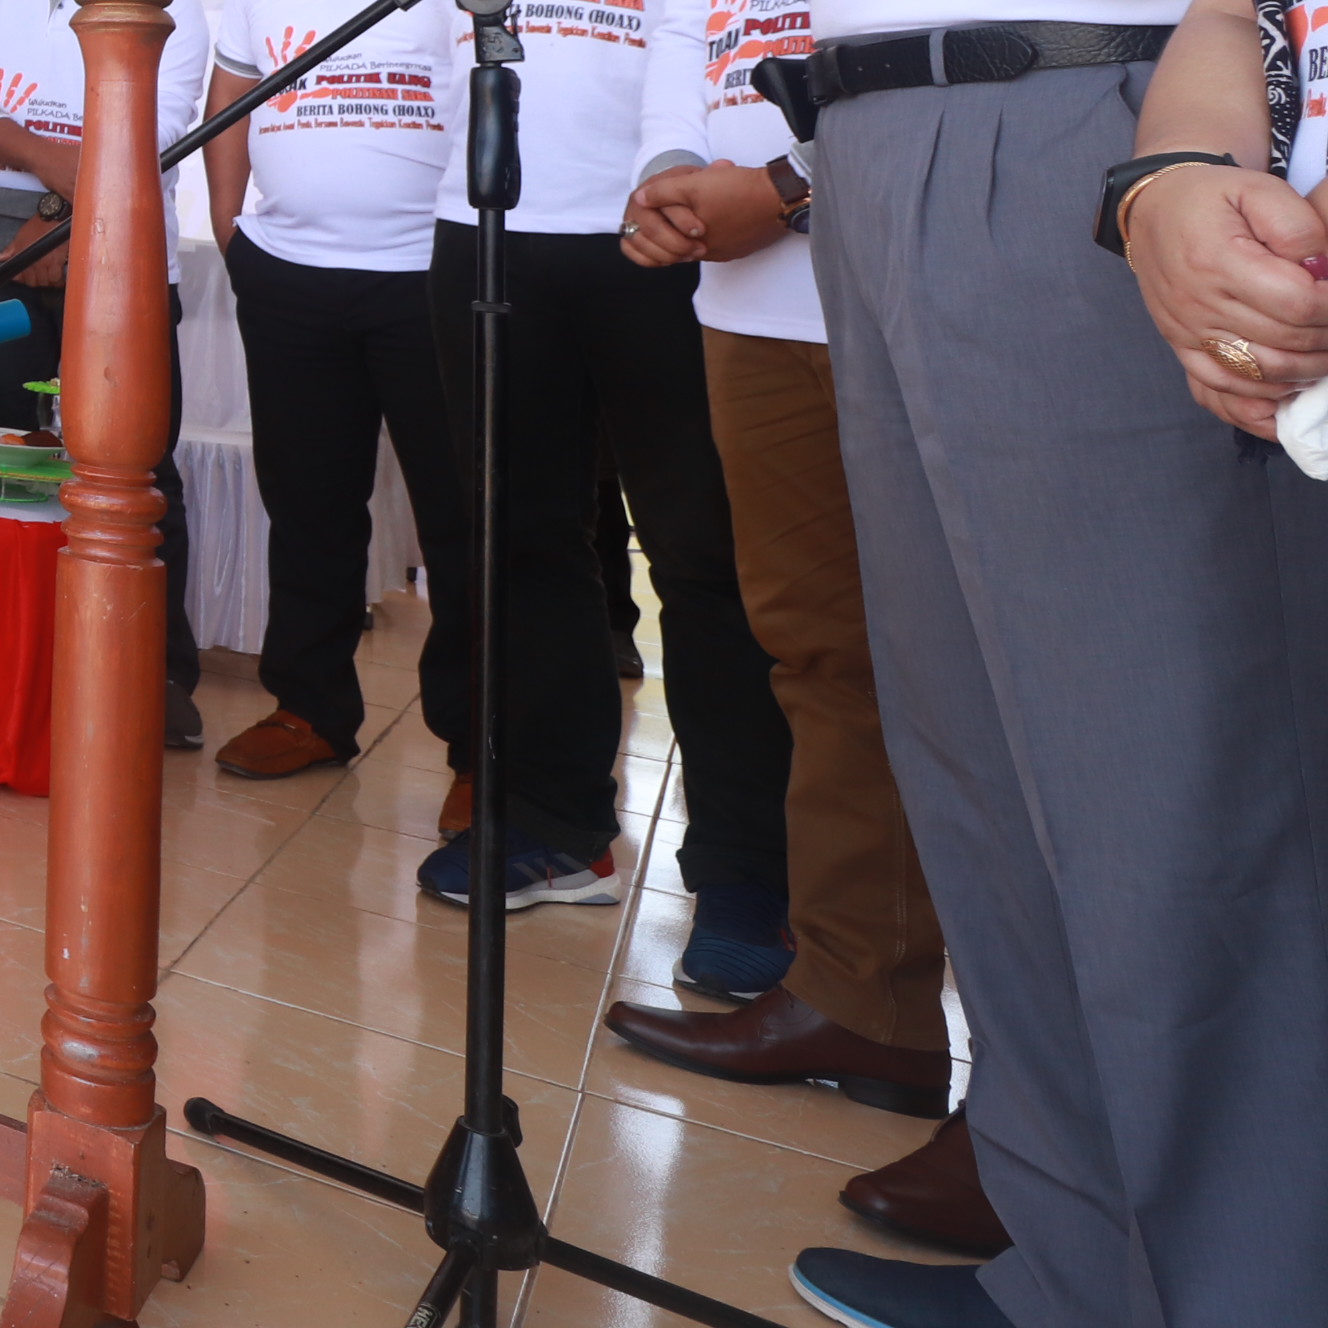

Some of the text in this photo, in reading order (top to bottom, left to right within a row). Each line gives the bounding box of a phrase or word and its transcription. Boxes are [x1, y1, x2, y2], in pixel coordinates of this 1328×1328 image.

[525, 3, 585, 22] BOHONG
[589, 9, 641, 33] (HOAX)
[320, 62, 367, 72] PILKADA
[315, 72, 382, 86] POLITIK
[387, 72, 432, 89] UANG
[27, 108, 70, 121] PILKADA
[296, 103, 436, 119] BERITA BOHONG (HOAX)
